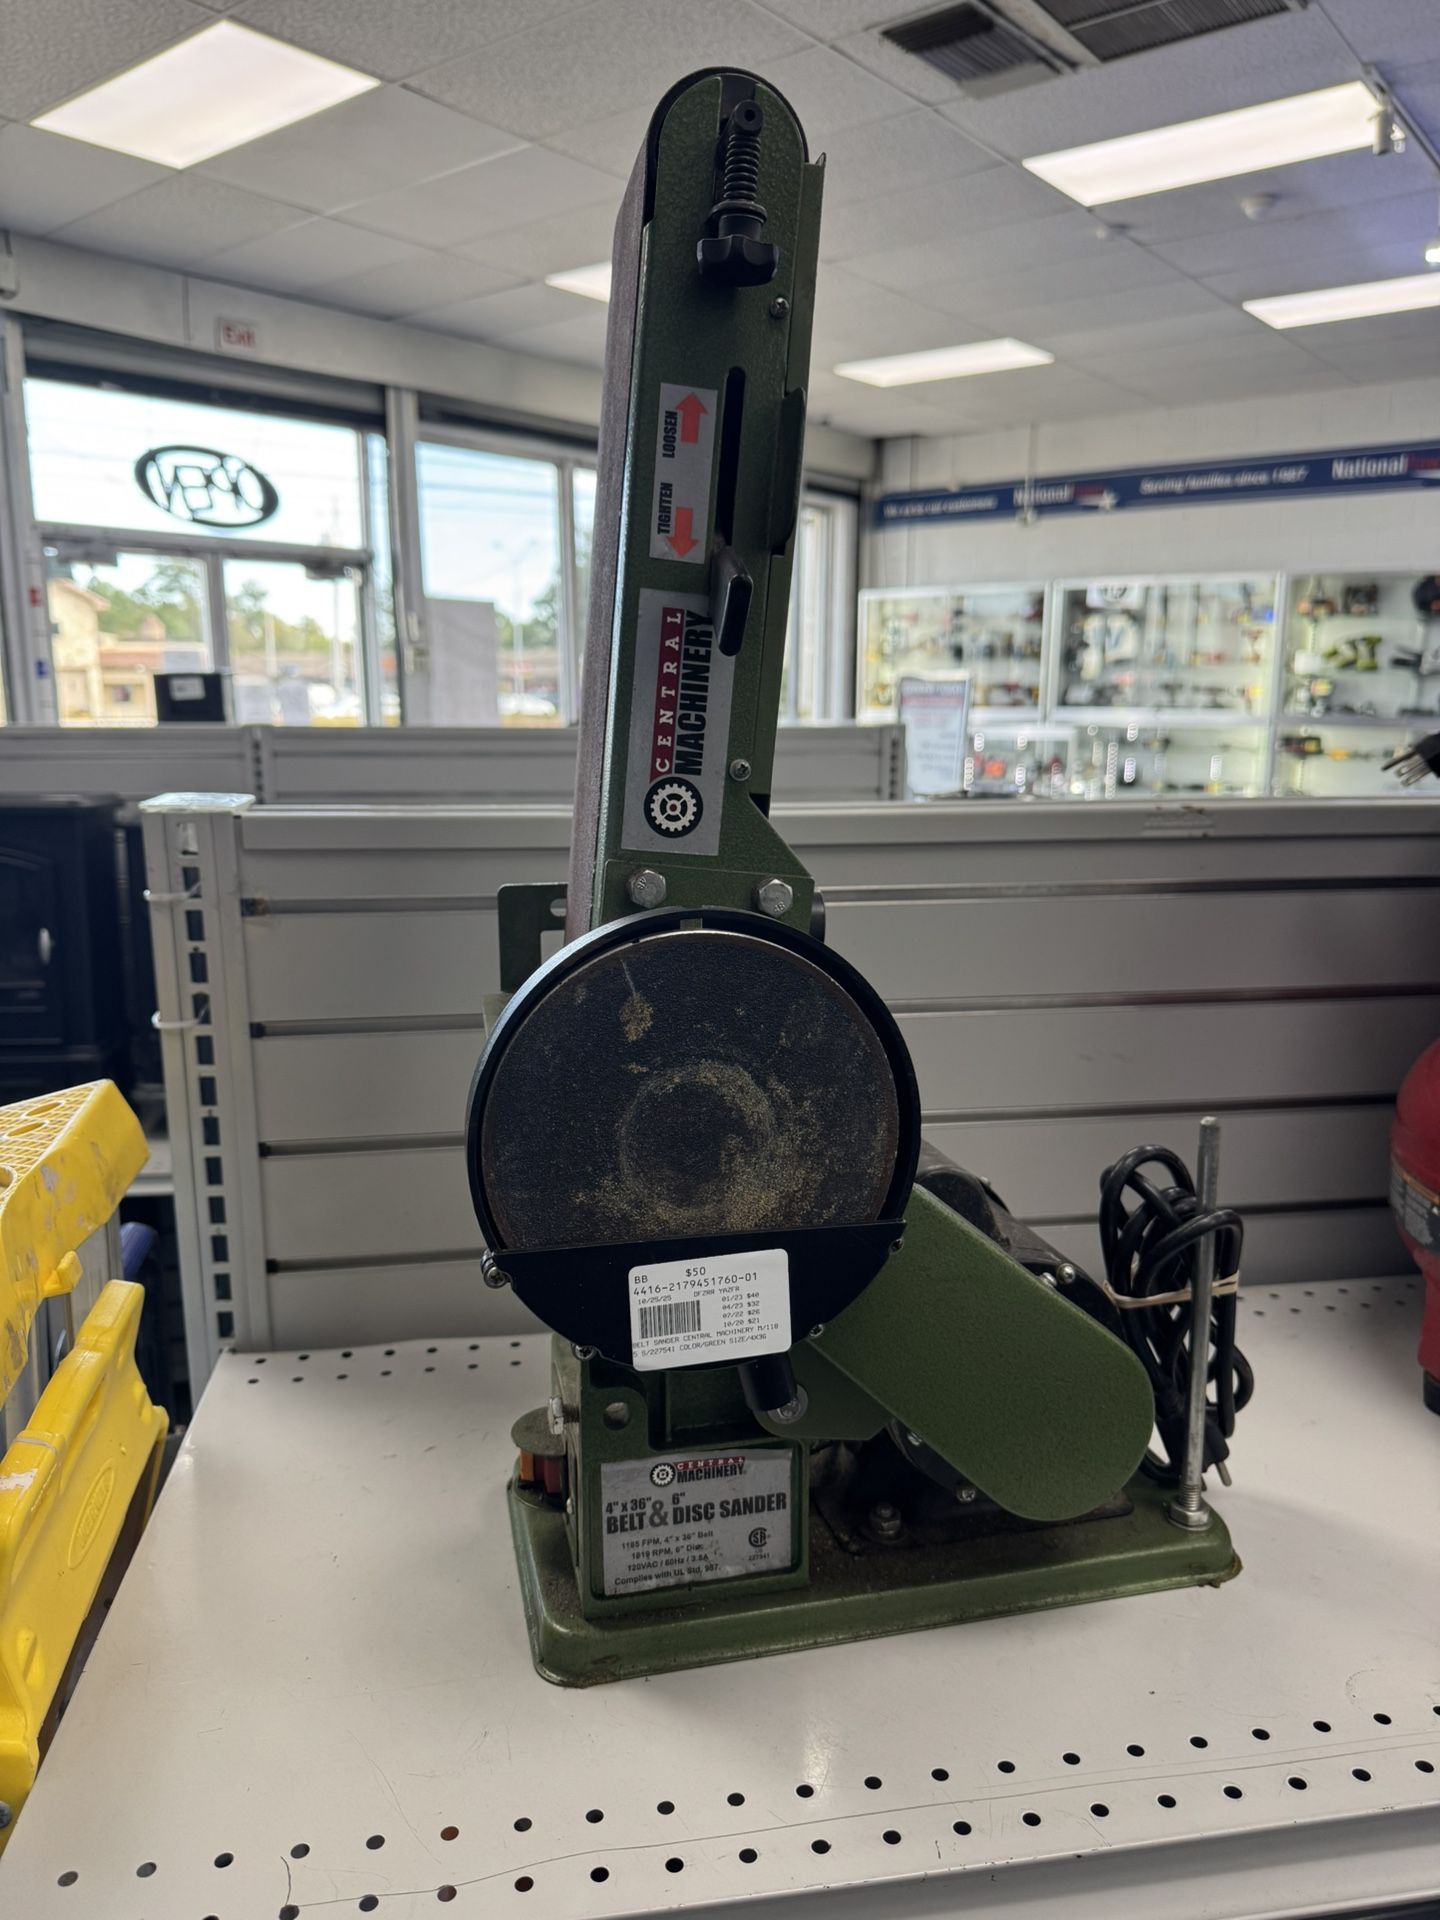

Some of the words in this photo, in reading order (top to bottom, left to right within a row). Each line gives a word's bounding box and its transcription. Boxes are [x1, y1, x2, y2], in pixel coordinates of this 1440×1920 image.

[662, 410, 678, 459] LOOSEN
[1331, 452, 1405, 480] National
[657, 482, 673, 535] TIGHTEN
[655, 612, 682, 773] CENTRAL
[674, 609, 713, 776] MACHINERY
[633, 1272, 757, 1296] 4416-2179451760-01
[634, 1275, 648, 1284] BB
[685, 1267, 706, 1277] $50
[638, 1295, 672, 1305] 10/25/25
[632, 1341, 649, 1349] BELT
[653, 1336, 680, 1346] SANDER
[683, 1332, 713, 1342] CENTRAL
[716, 1326, 754, 1337] MACHINERY
[679, 1339, 726, 1352] COLOR/GREEN
[677, 1457, 744, 1469] CENTRAL
[677, 1463, 744, 1484] MACHINERY
[605, 1502, 619, 1514] 4"
[620, 1503, 629, 1512] x
[630, 1497, 652, 1511] 36"
[671, 1492, 686, 1505] 6"
[606, 1512, 646, 1534] BELT
[648, 1500, 668, 1528] &
[672, 1502, 715, 1526] DISC
[720, 1492, 787, 1518] SANDER
[697, 1530, 713, 1538] Belt
[627, 1560, 658, 1571] 120VAC
[664, 1557, 684, 1566] 60Hz
[614, 1573, 653, 1586] Complies
[654, 1570, 672, 1580] with
[673, 1568, 685, 1577] UL
